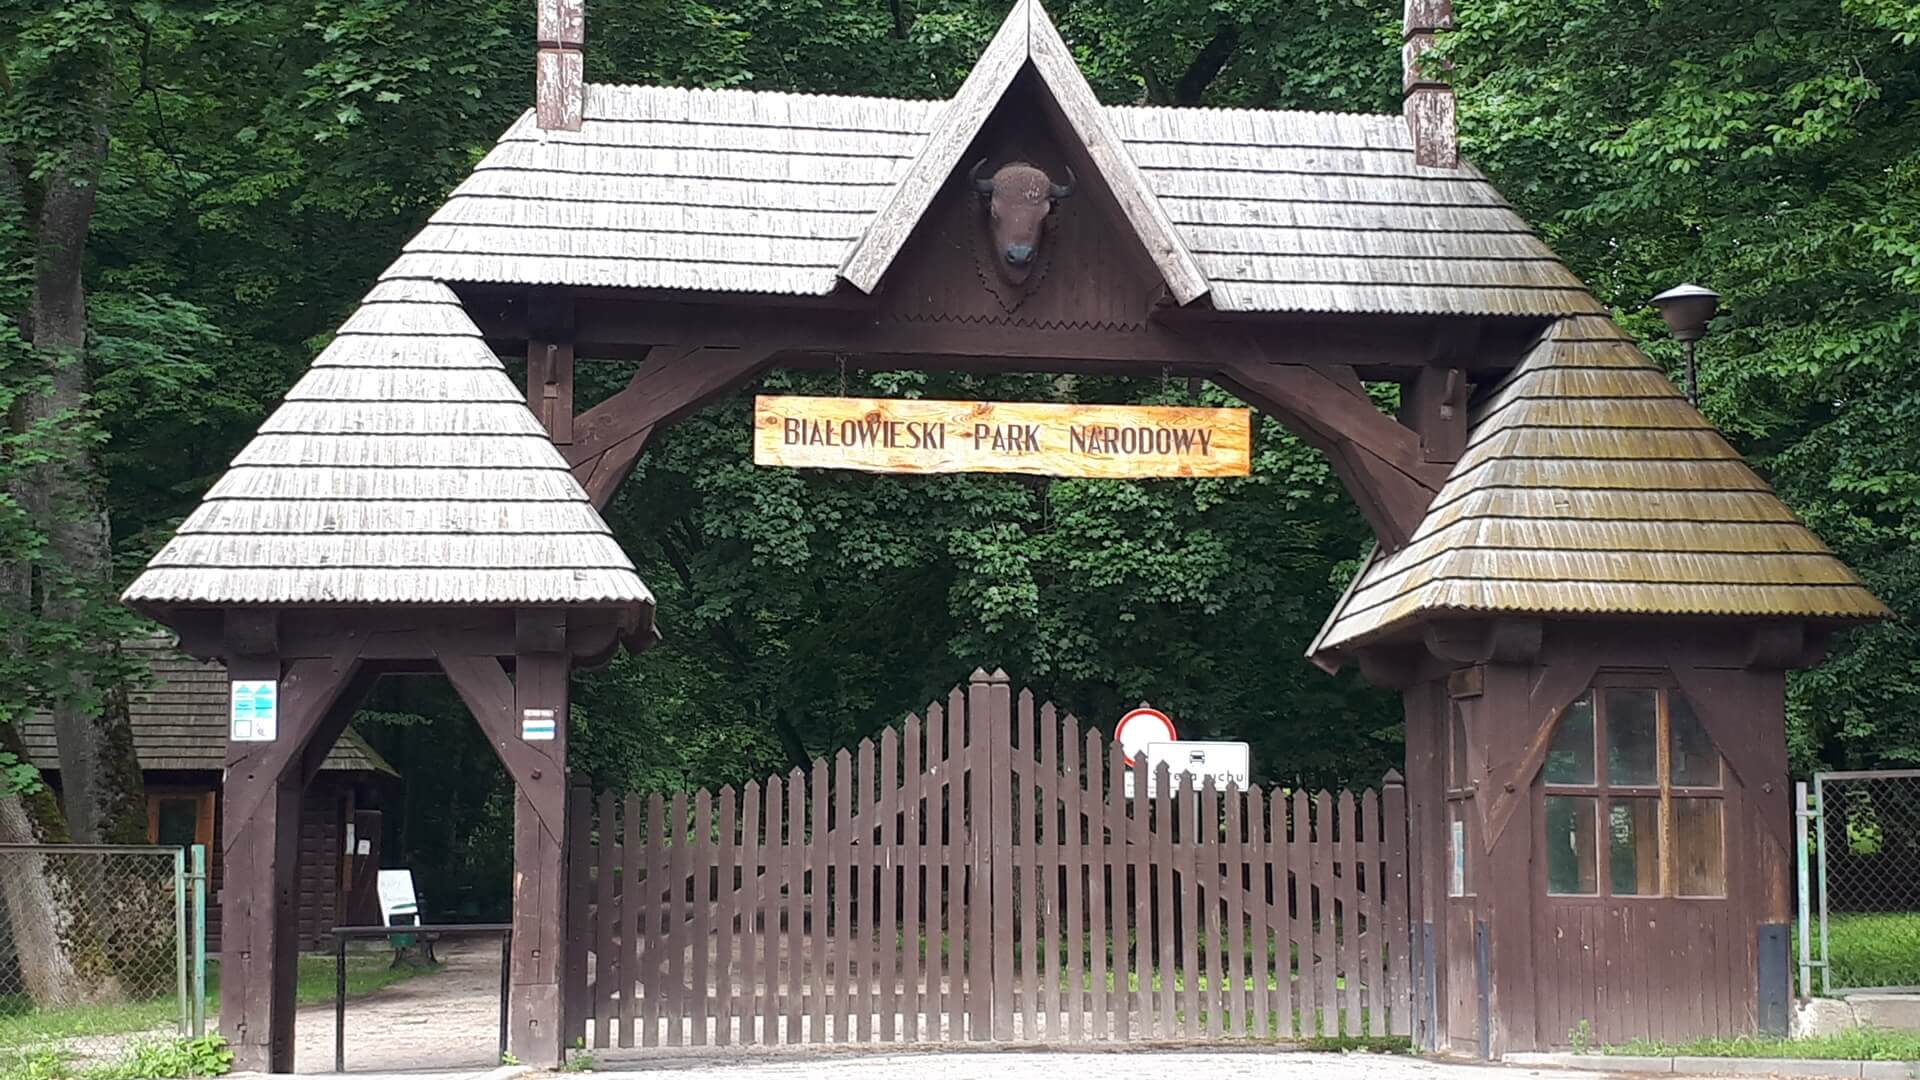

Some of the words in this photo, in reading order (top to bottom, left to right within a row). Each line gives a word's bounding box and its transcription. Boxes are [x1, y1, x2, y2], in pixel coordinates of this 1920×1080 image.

[784, 417, 945, 450] BIAŁOWIESKI
[974, 423, 1041, 453] PARK
[1069, 425, 1213, 457] NARODOWY
